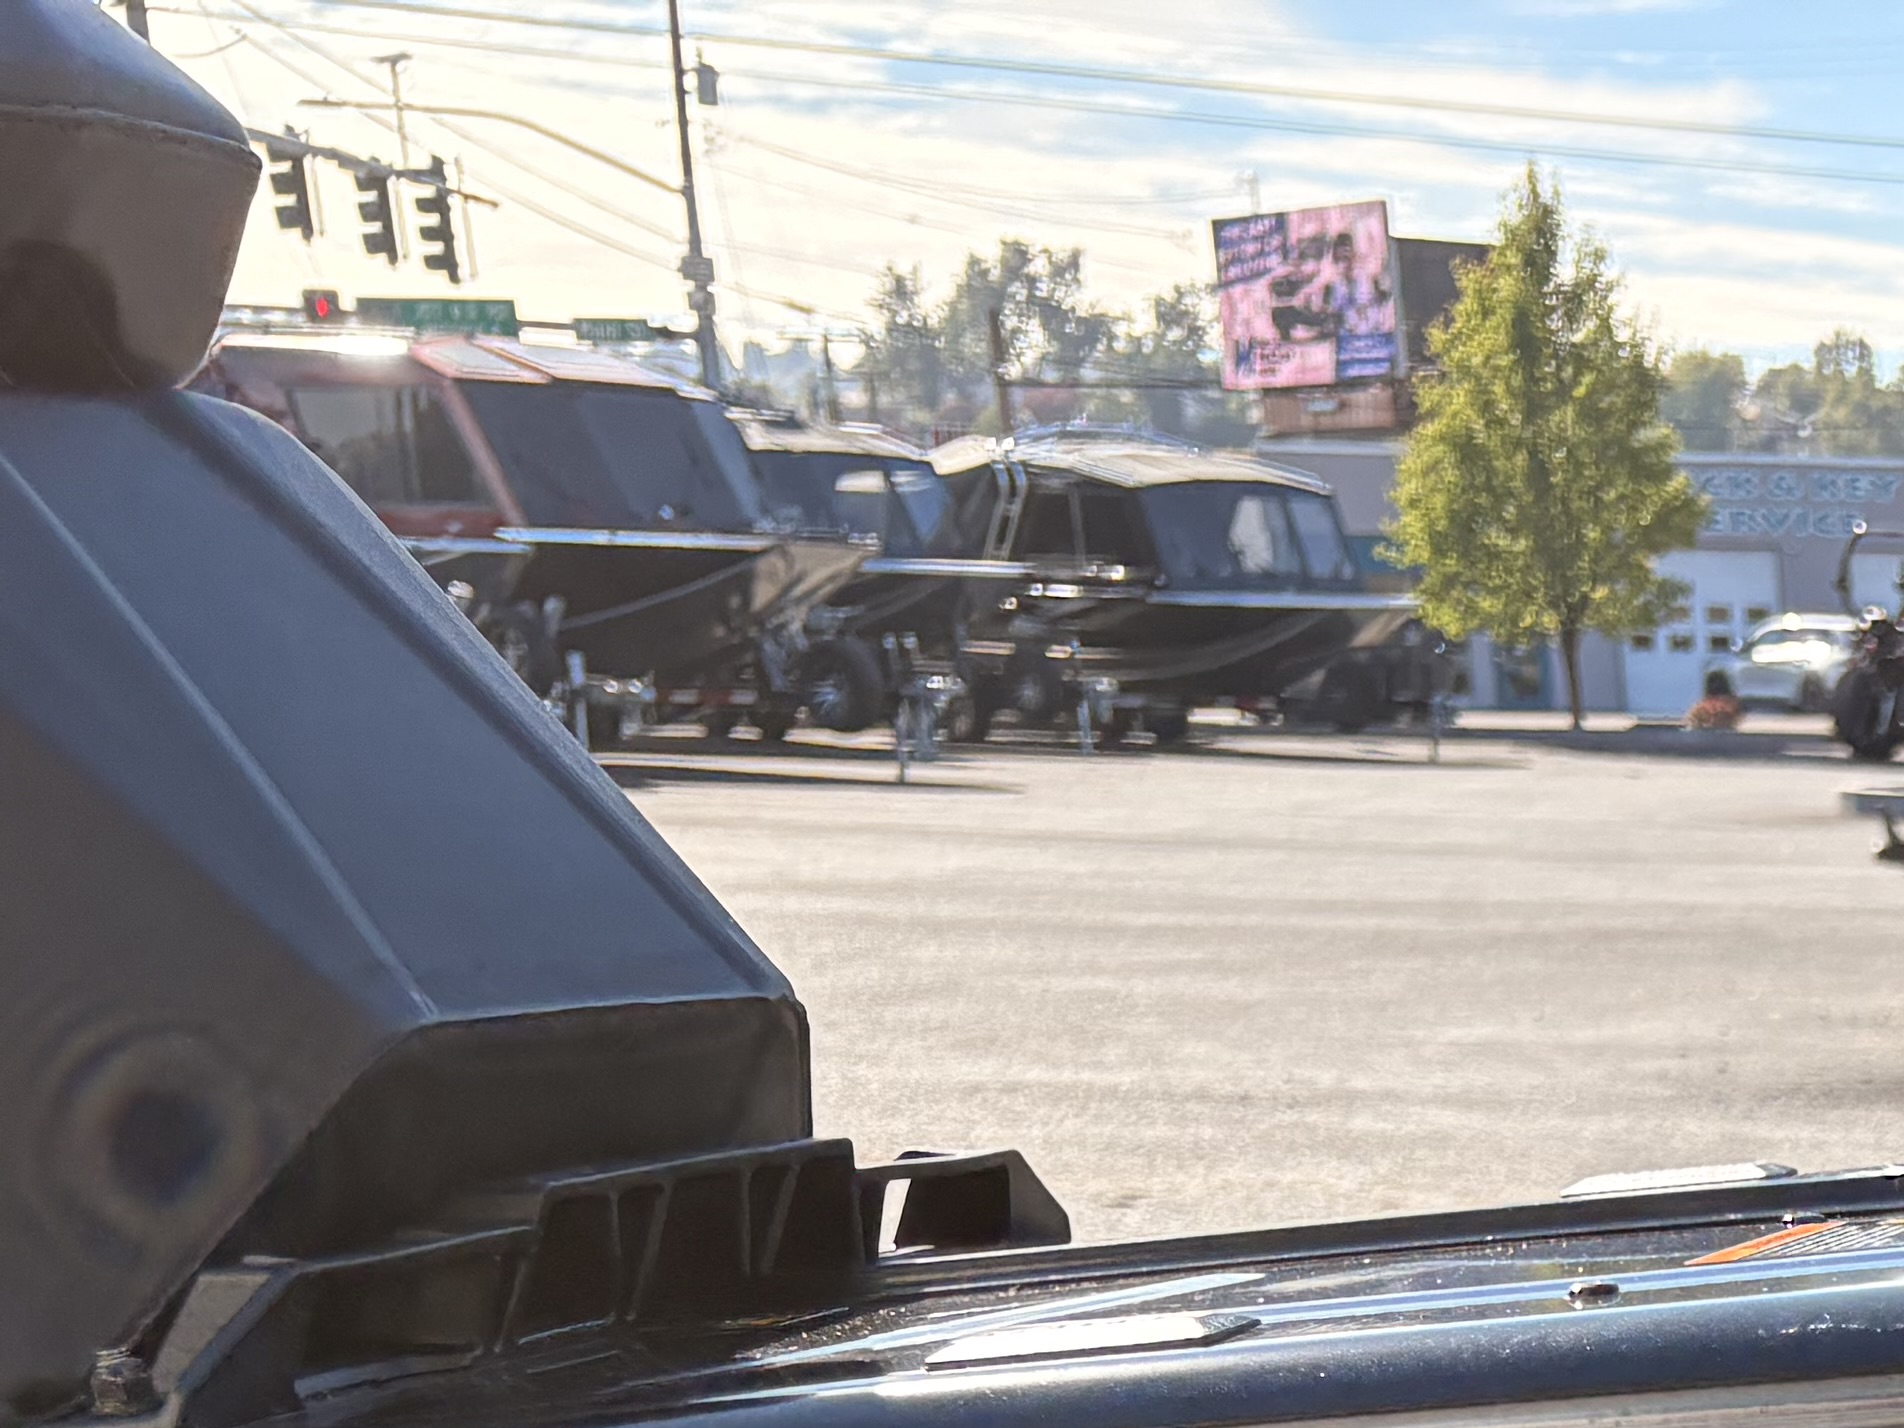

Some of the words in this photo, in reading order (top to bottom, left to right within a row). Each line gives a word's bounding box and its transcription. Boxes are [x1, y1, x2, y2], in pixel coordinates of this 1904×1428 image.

[1702, 471, 1760, 499] CK
[1808, 472, 1902, 504] KEY
[1704, 505, 1867, 538] ERVICE
